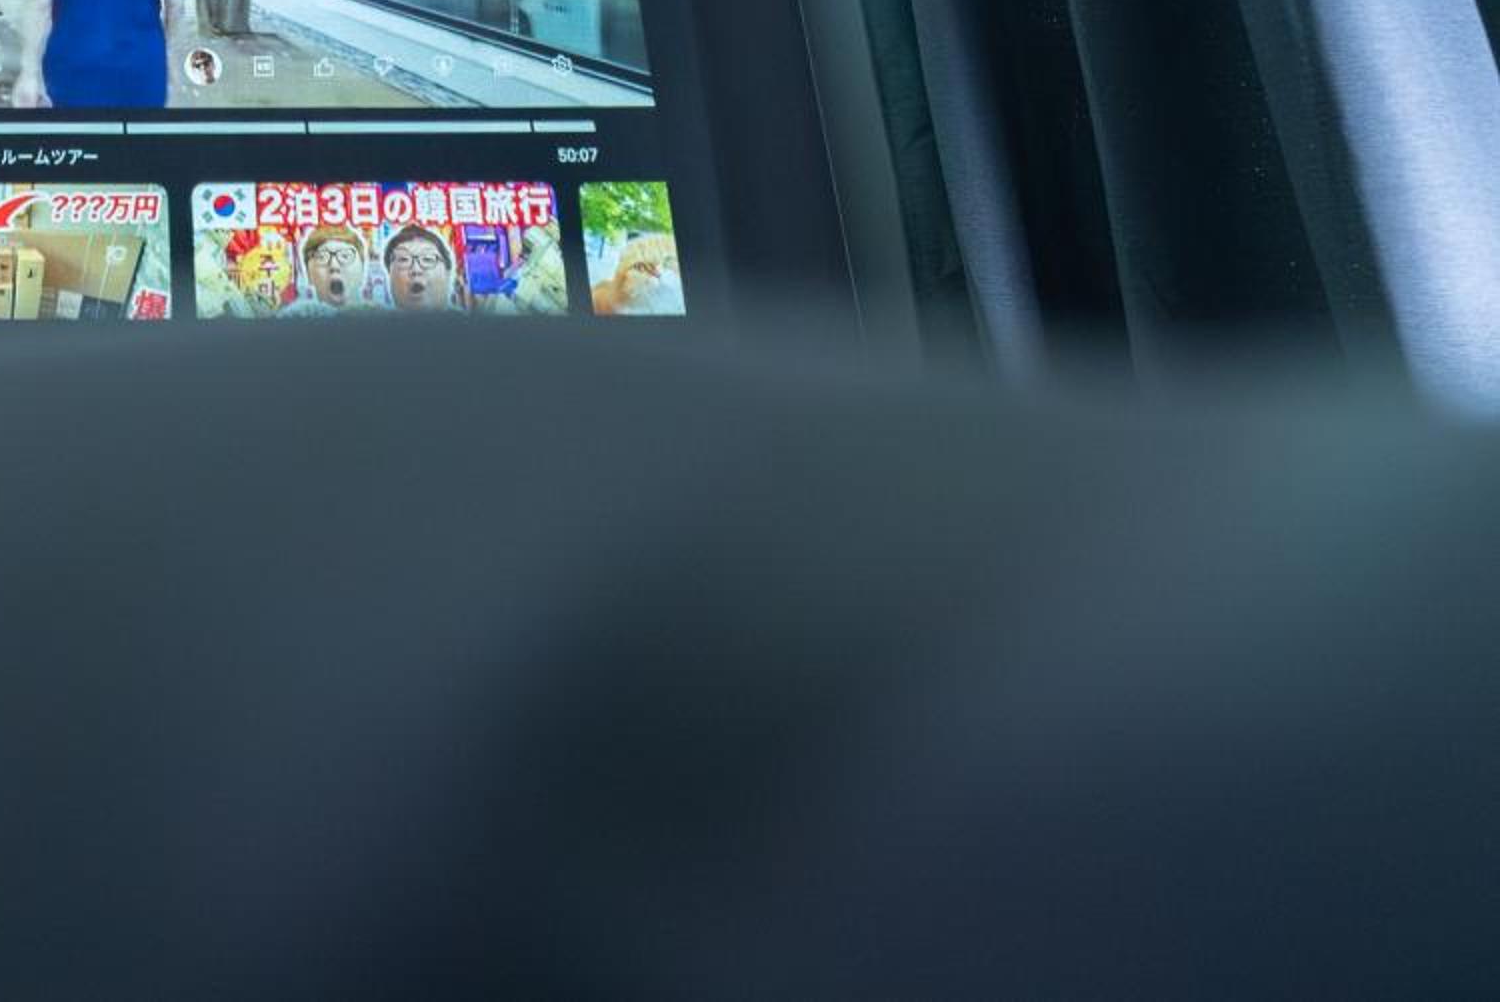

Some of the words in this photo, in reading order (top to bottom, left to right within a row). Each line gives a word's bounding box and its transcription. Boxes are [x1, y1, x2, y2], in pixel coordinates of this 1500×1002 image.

[557, 147, 598, 164] 50:07
[50, 193, 161, 222] ???万円
[258, 185, 551, 225] 2泊3日の韓国旅行
